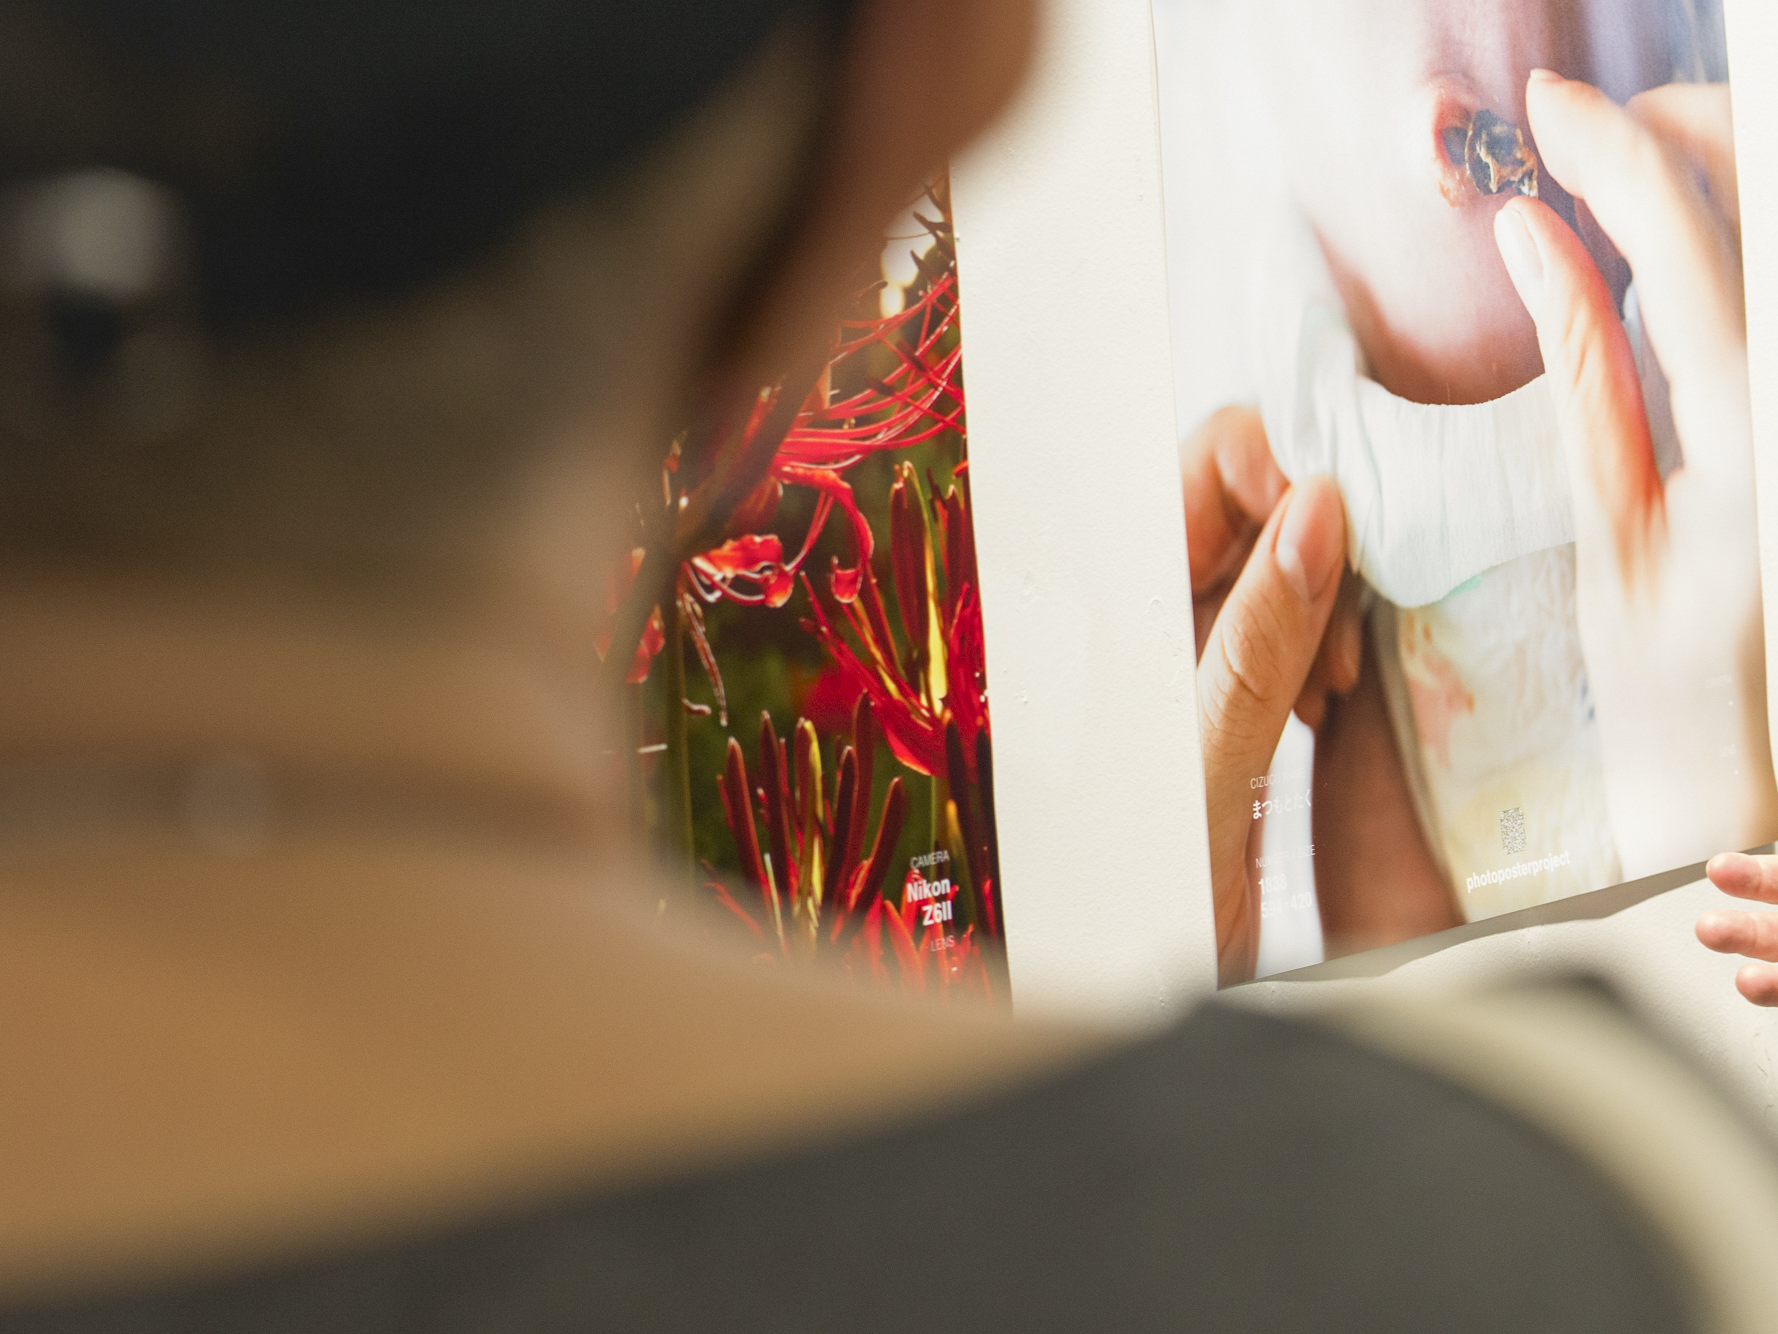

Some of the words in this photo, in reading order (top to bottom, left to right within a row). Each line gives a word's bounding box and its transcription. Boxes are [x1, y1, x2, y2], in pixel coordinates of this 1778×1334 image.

[1252, 789, 1311, 820] まつもとたく
[910, 850, 950, 869] CAMERA
[1466, 850, 1571, 894] photoposterproject
[907, 879, 950, 902] Nikon
[931, 935, 955, 951] LENS
